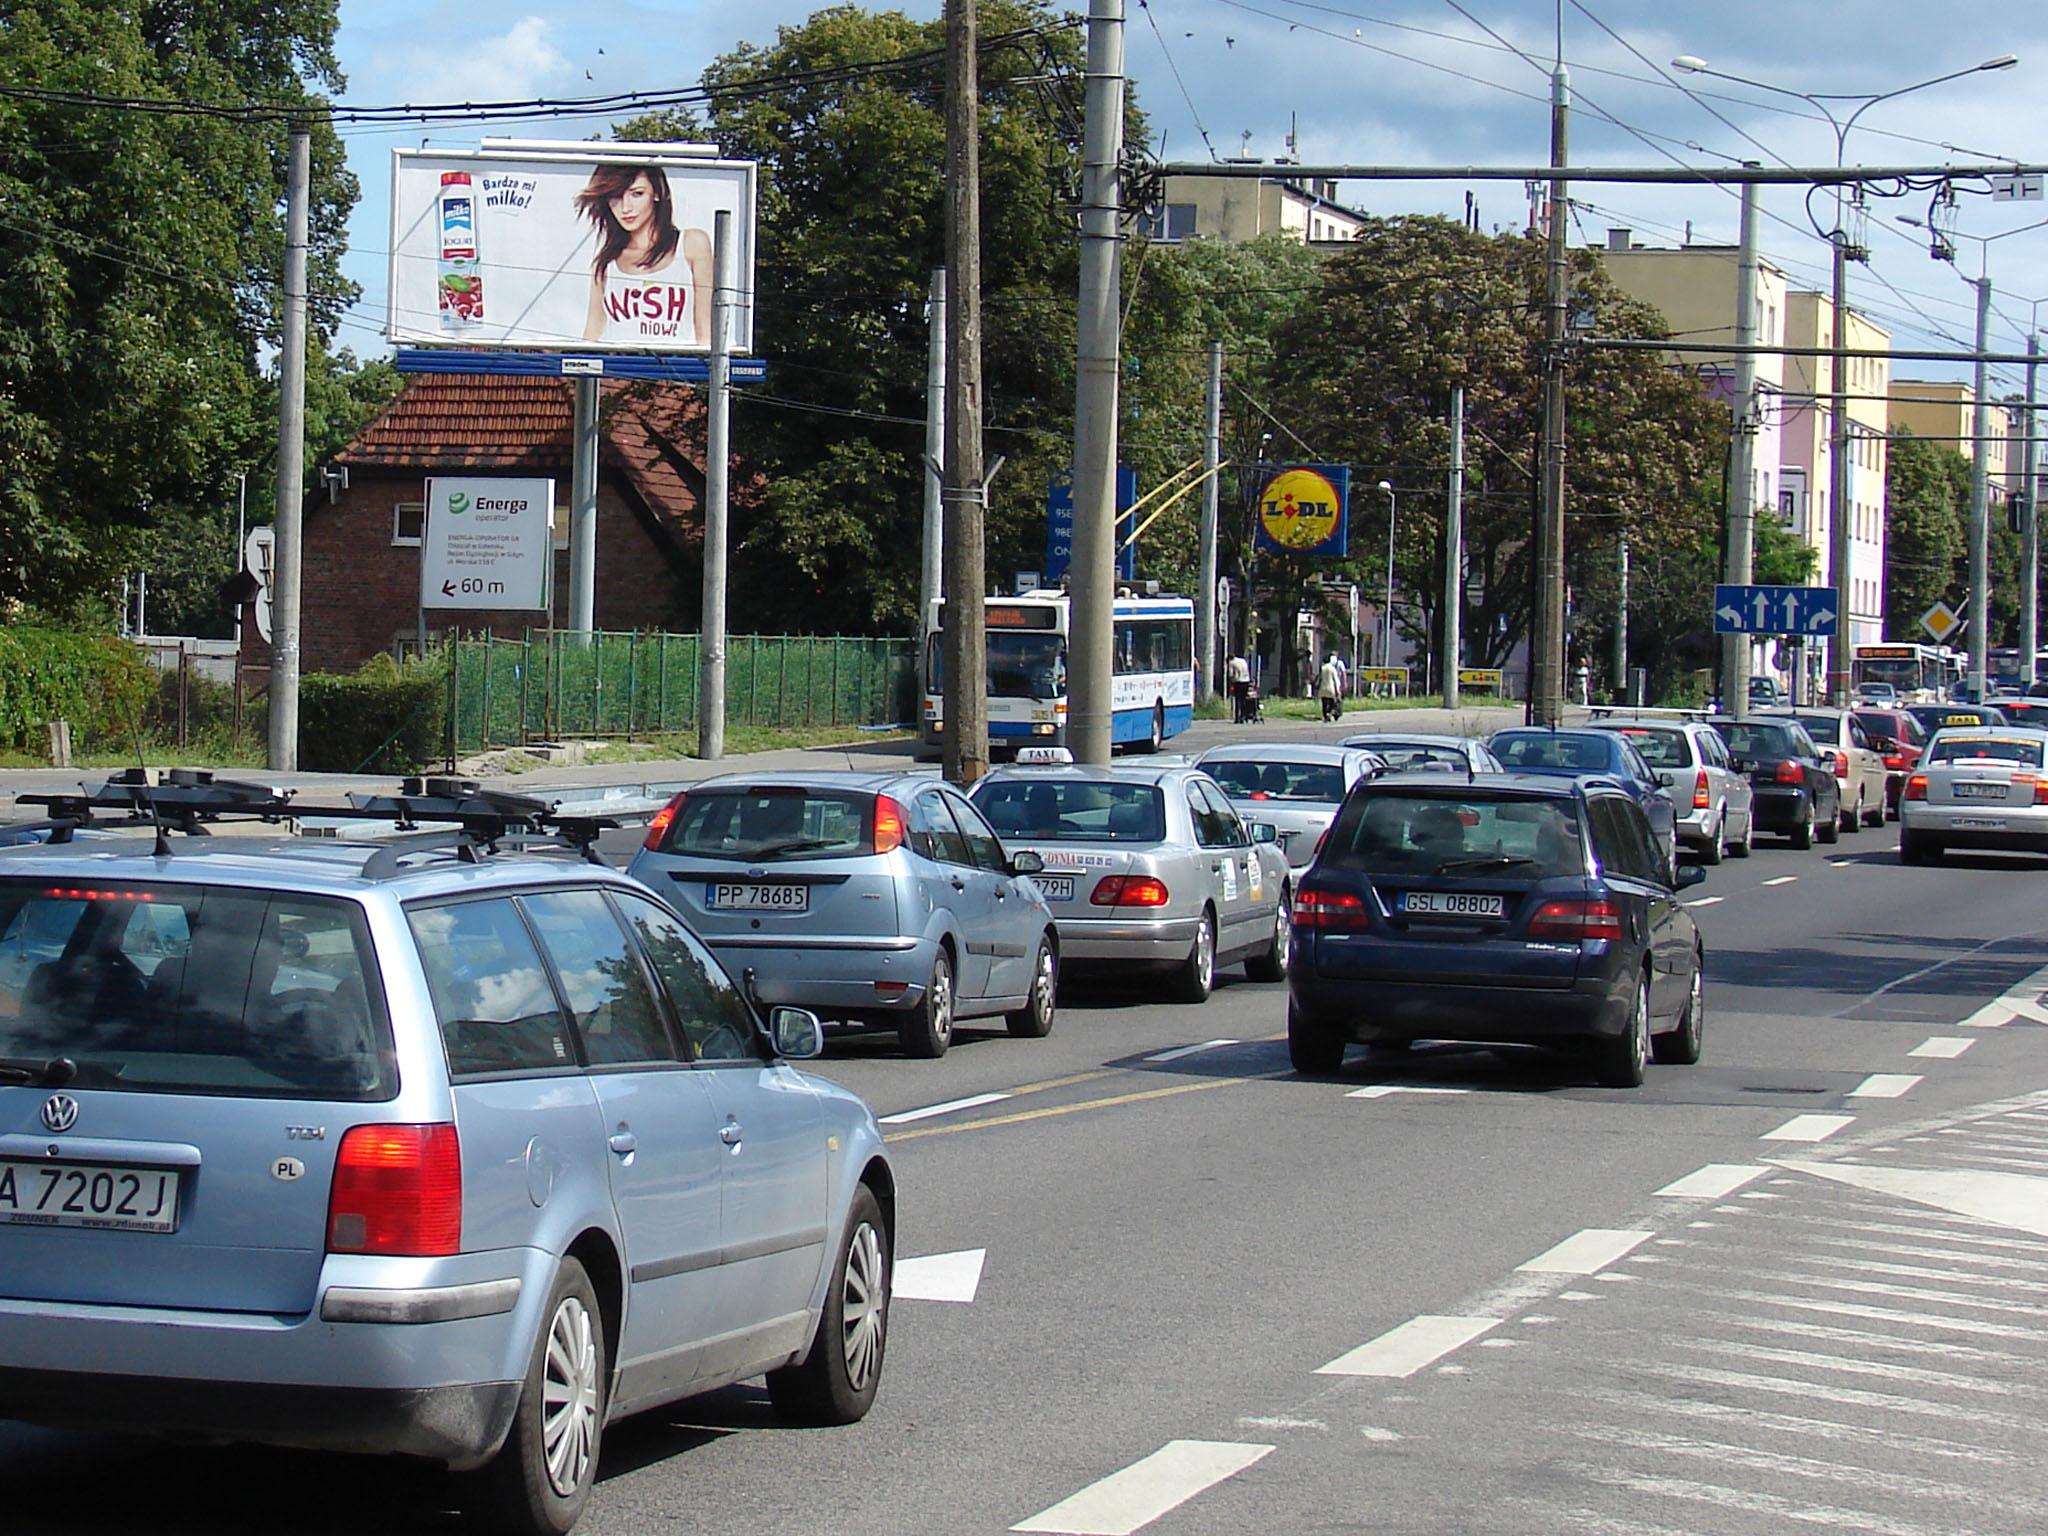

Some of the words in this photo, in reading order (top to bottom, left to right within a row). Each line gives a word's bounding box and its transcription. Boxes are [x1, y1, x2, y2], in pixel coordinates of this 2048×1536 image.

[483, 176, 519, 191] Bardzo
[521, 180, 537, 192] mi
[486, 190, 532, 208] milko!
[476, 497, 528, 514] Energa
[461, 578, 483, 593] 60
[488, 581, 504, 593] m
[1028, 749, 1055, 759] TAXI
[1045, 852, 1075, 865] DYNIA
[717, 886, 743, 904] PP
[749, 886, 805, 905] 78685
[1407, 894, 1439, 911] GSL
[1446, 896, 1502, 914] 08802
[277, 1162, 297, 1177] PL
[37, 1169, 166, 1217] 7202J
